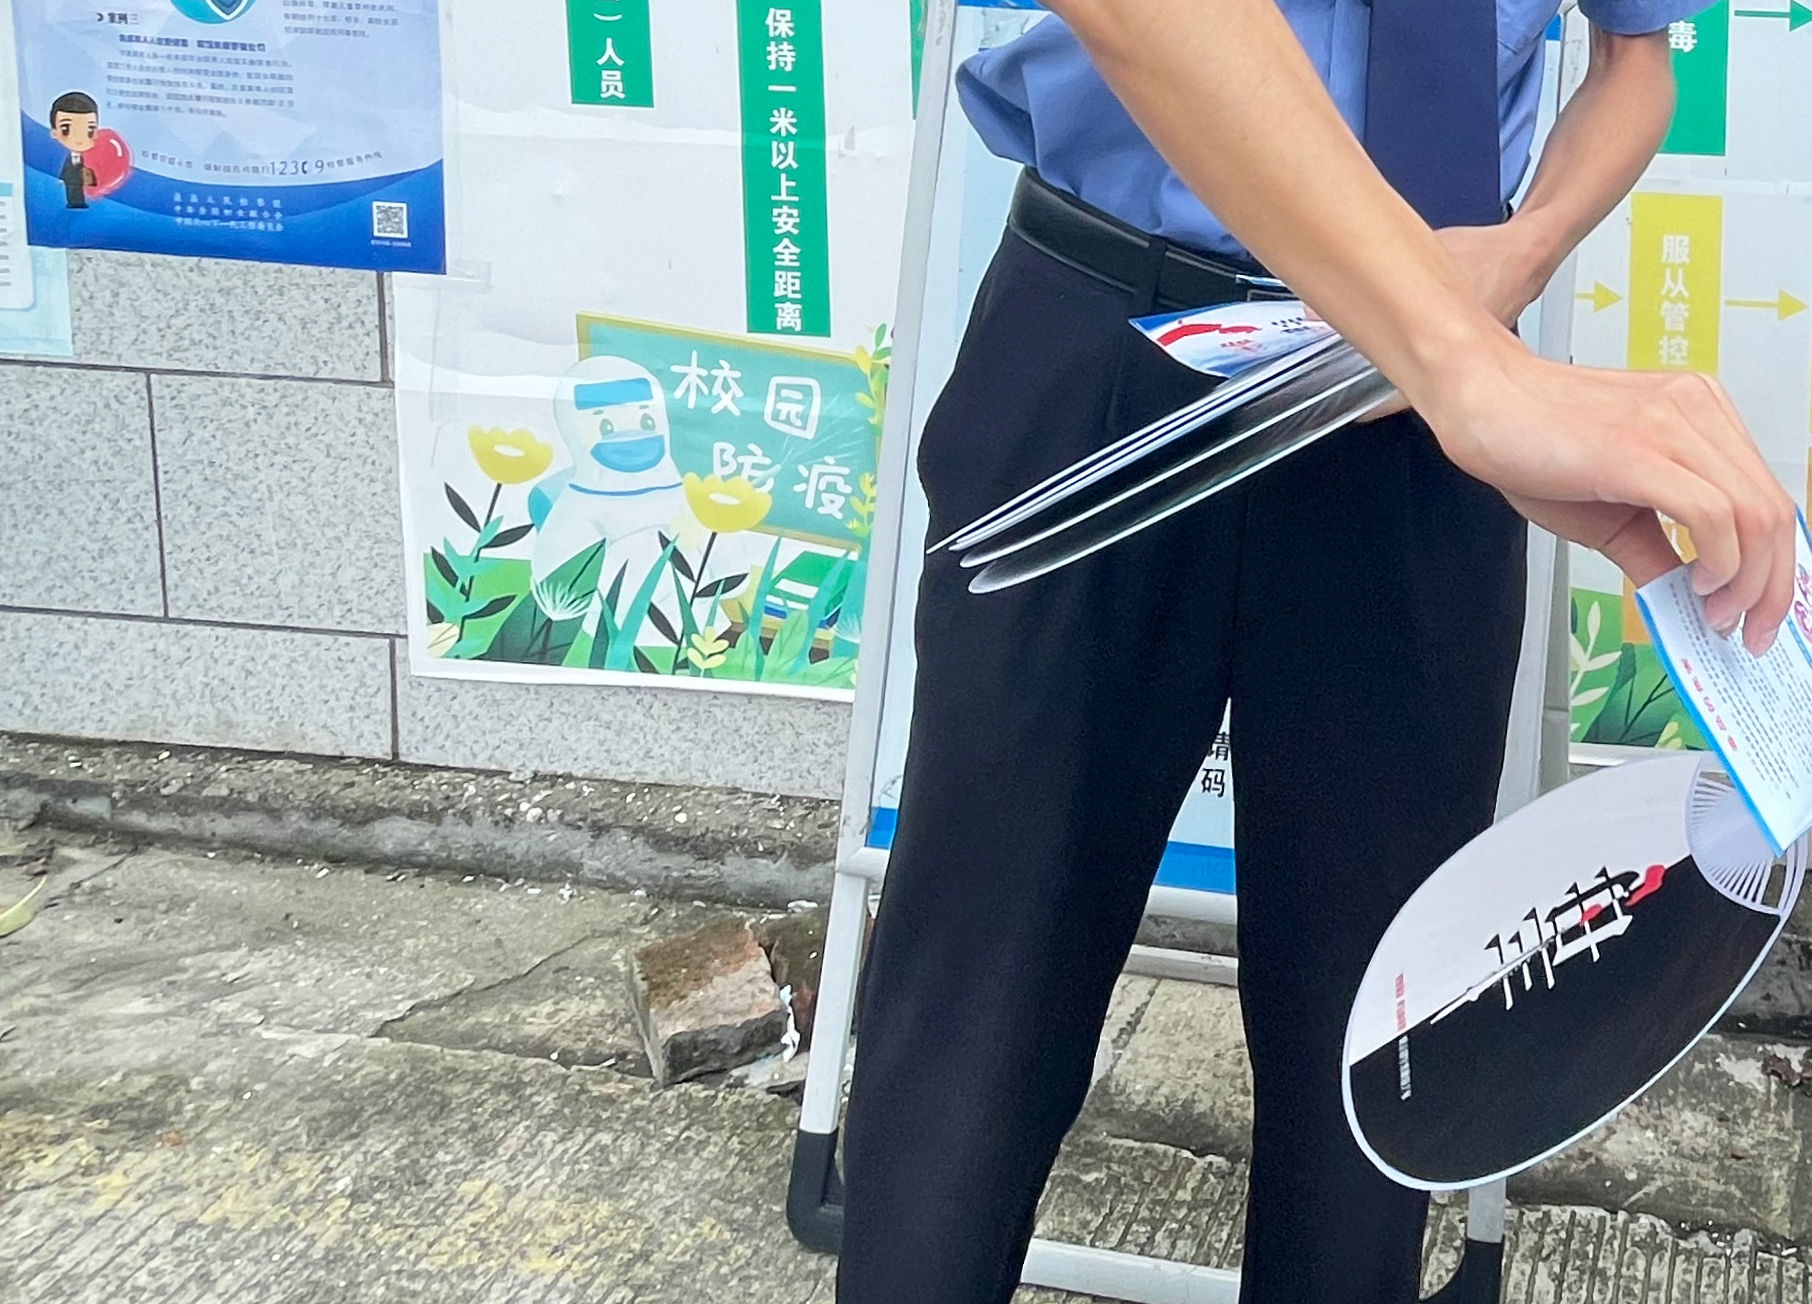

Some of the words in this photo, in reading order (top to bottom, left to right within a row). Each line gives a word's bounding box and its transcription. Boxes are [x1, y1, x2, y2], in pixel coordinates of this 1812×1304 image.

[1659, 233, 1691, 367] 服从管控
[668, 349, 821, 440] 校园
[712, 442, 854, 520] 防疫
[1201, 768, 1226, 798] 码
